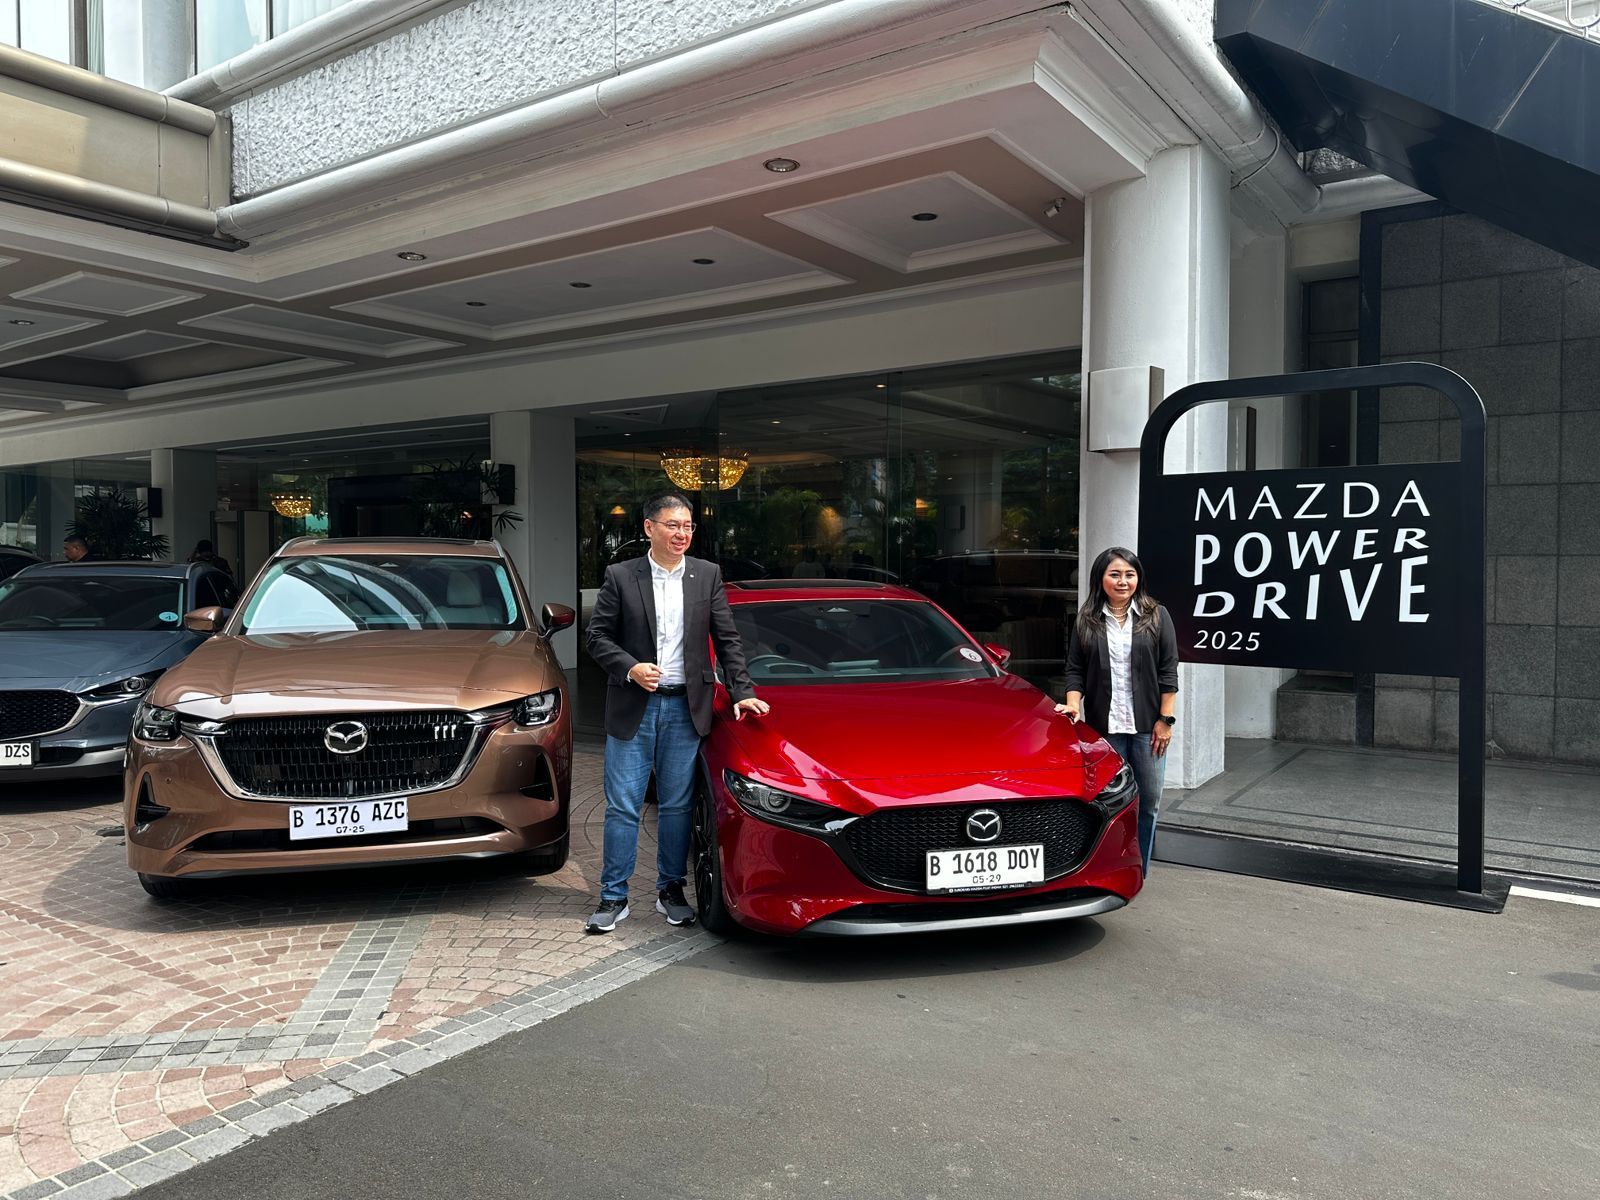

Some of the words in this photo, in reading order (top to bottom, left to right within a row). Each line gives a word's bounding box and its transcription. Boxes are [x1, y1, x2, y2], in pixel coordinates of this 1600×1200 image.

[1194, 480, 1430, 521] MAZDA
[1193, 528, 1429, 586] POWER
[1193, 555, 1430, 623] DRIVE
[1193, 630, 1260, 651] 2025
[5, 745, 30, 758] DZS
[293, 810, 304, 828] B
[315, 805, 360, 826] 1376
[372, 801, 405, 821] AZC
[930, 855, 941, 876] B
[952, 851, 998, 874] 1618
[1007, 848, 1040, 870] DOY
